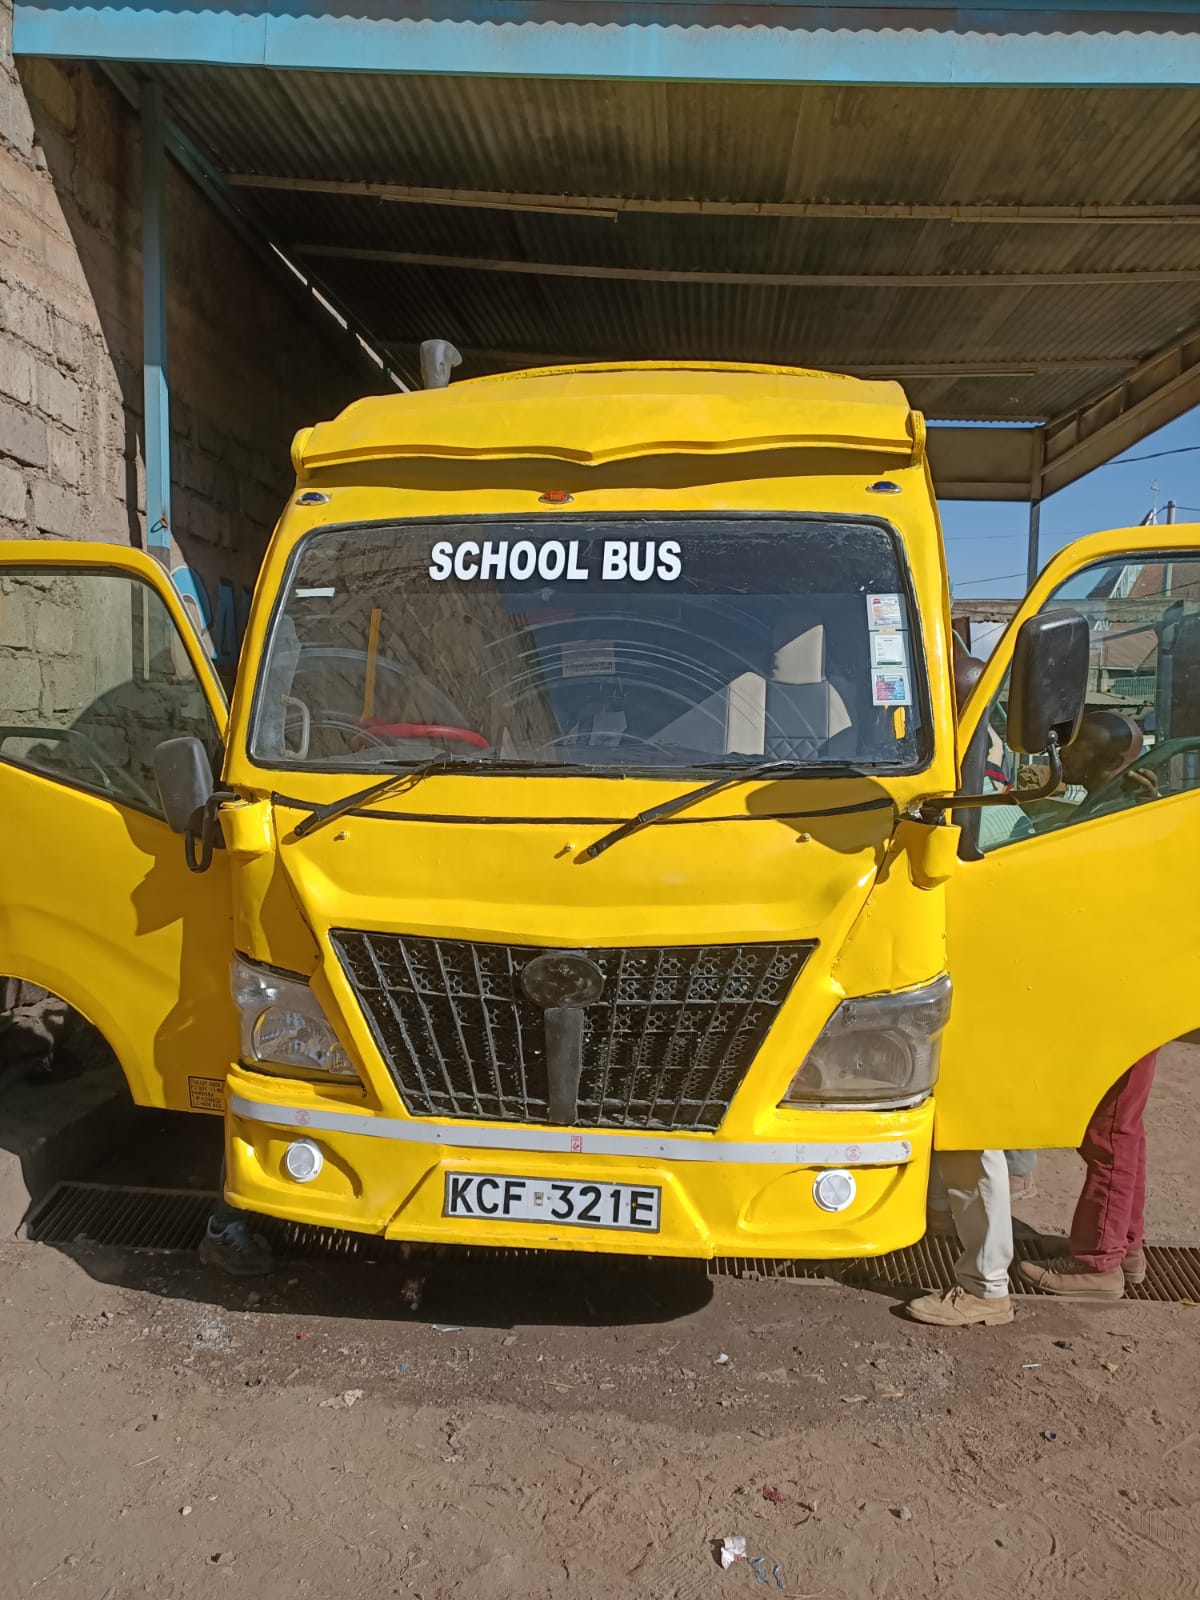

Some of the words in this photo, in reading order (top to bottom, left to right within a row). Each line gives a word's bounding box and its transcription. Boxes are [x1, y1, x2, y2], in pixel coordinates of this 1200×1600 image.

[428, 540, 589, 581] SCHOOL
[602, 541, 682, 581] BUS
[450, 1177, 526, 1214] KCF
[550, 1184, 654, 1226] 321E
